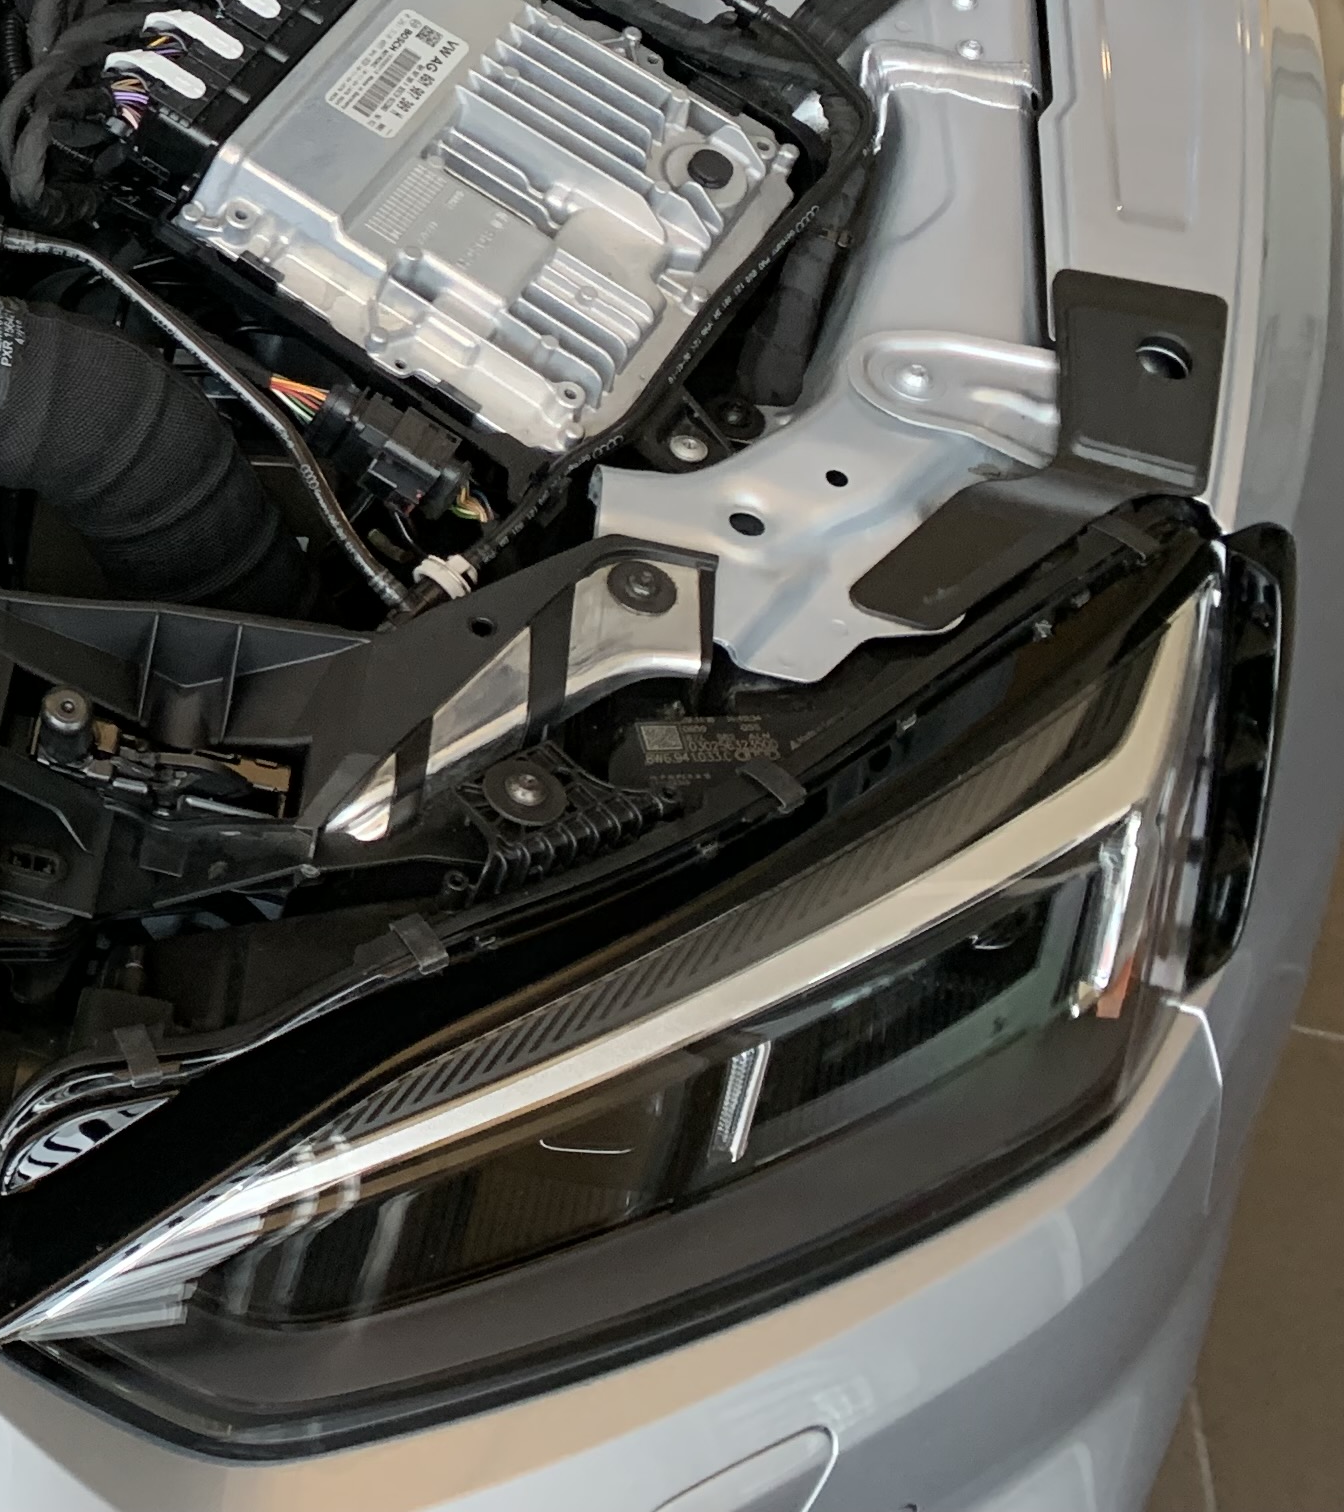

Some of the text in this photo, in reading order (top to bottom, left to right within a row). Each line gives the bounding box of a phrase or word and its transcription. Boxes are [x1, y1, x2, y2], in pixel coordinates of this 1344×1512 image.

[389, 28, 412, 51] BOSCH
[439, 40, 458, 57] VW
[425, 55, 442, 72] AG
[0, 340, 13, 366] PXR
